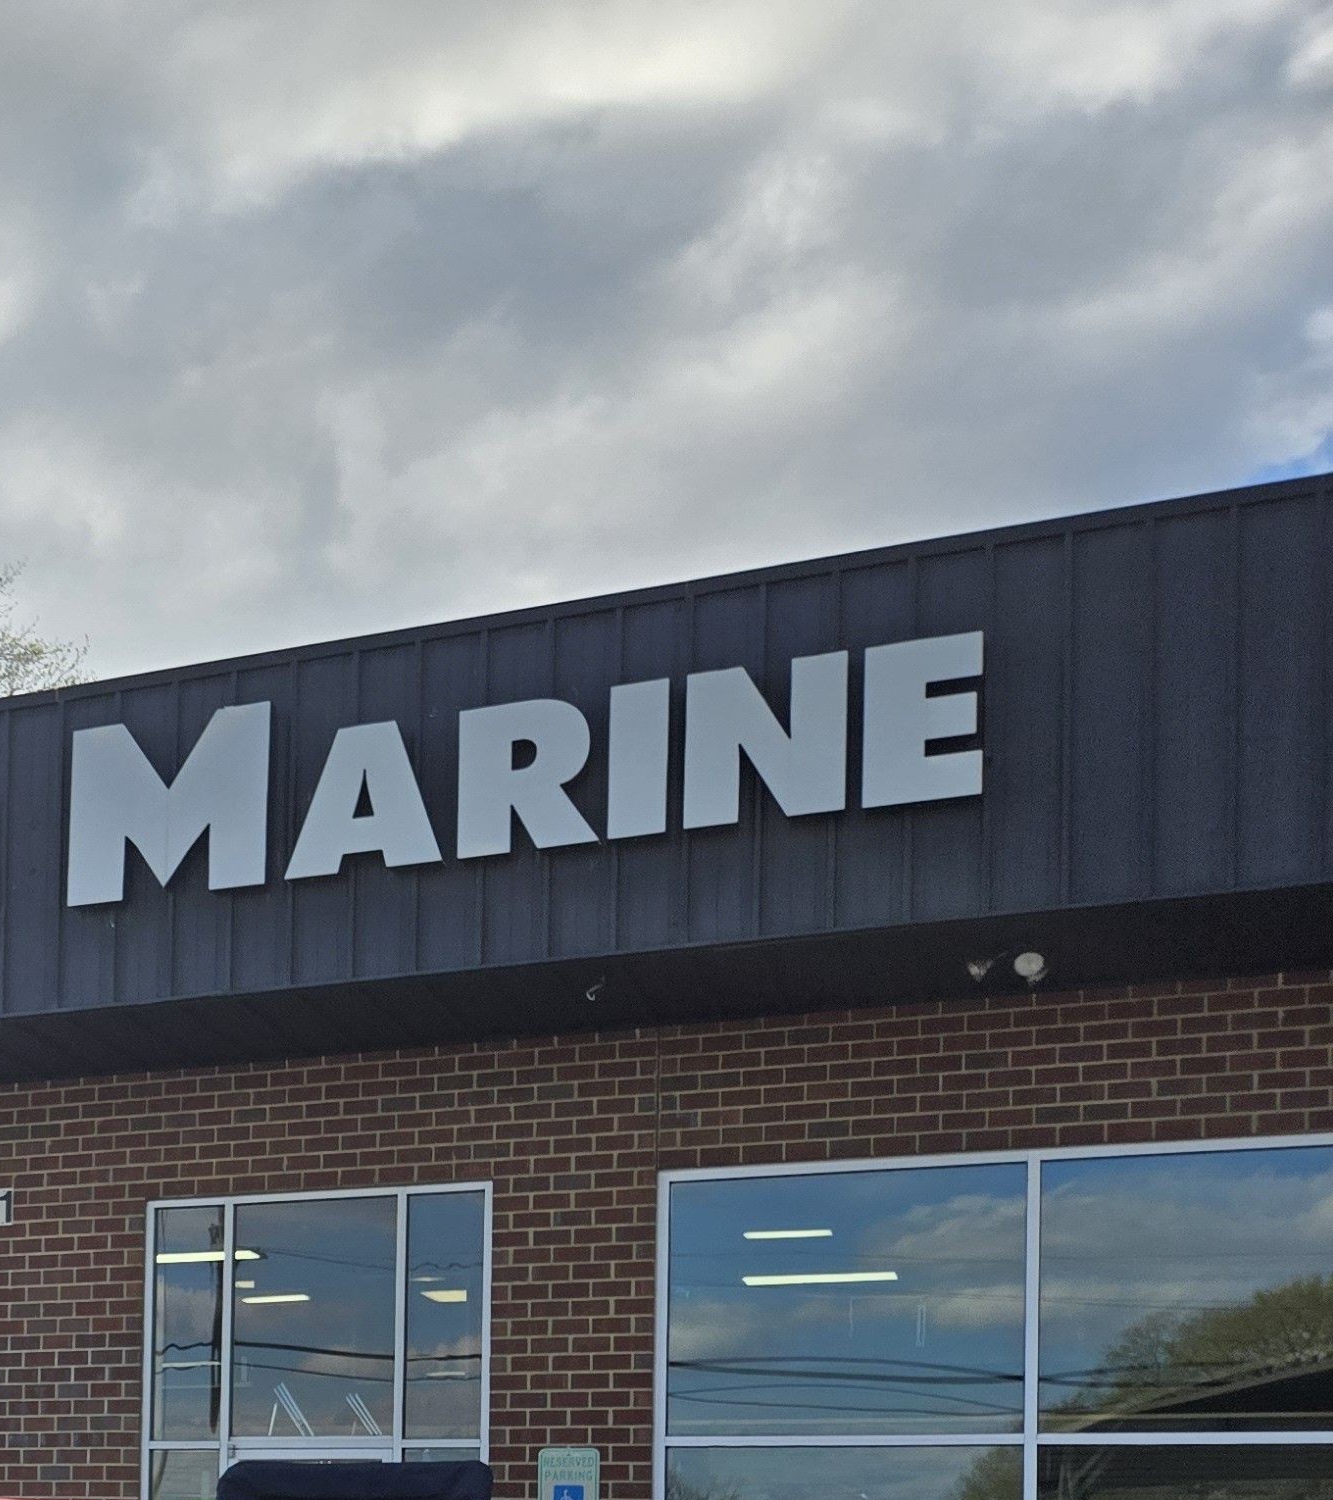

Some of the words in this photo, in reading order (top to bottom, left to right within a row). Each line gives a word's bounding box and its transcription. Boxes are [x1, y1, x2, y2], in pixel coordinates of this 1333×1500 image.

[66, 630, 985, 908] MARINE
[543, 1456, 594, 1468] RESERVED
[544, 1470, 593, 1480] PARKING
